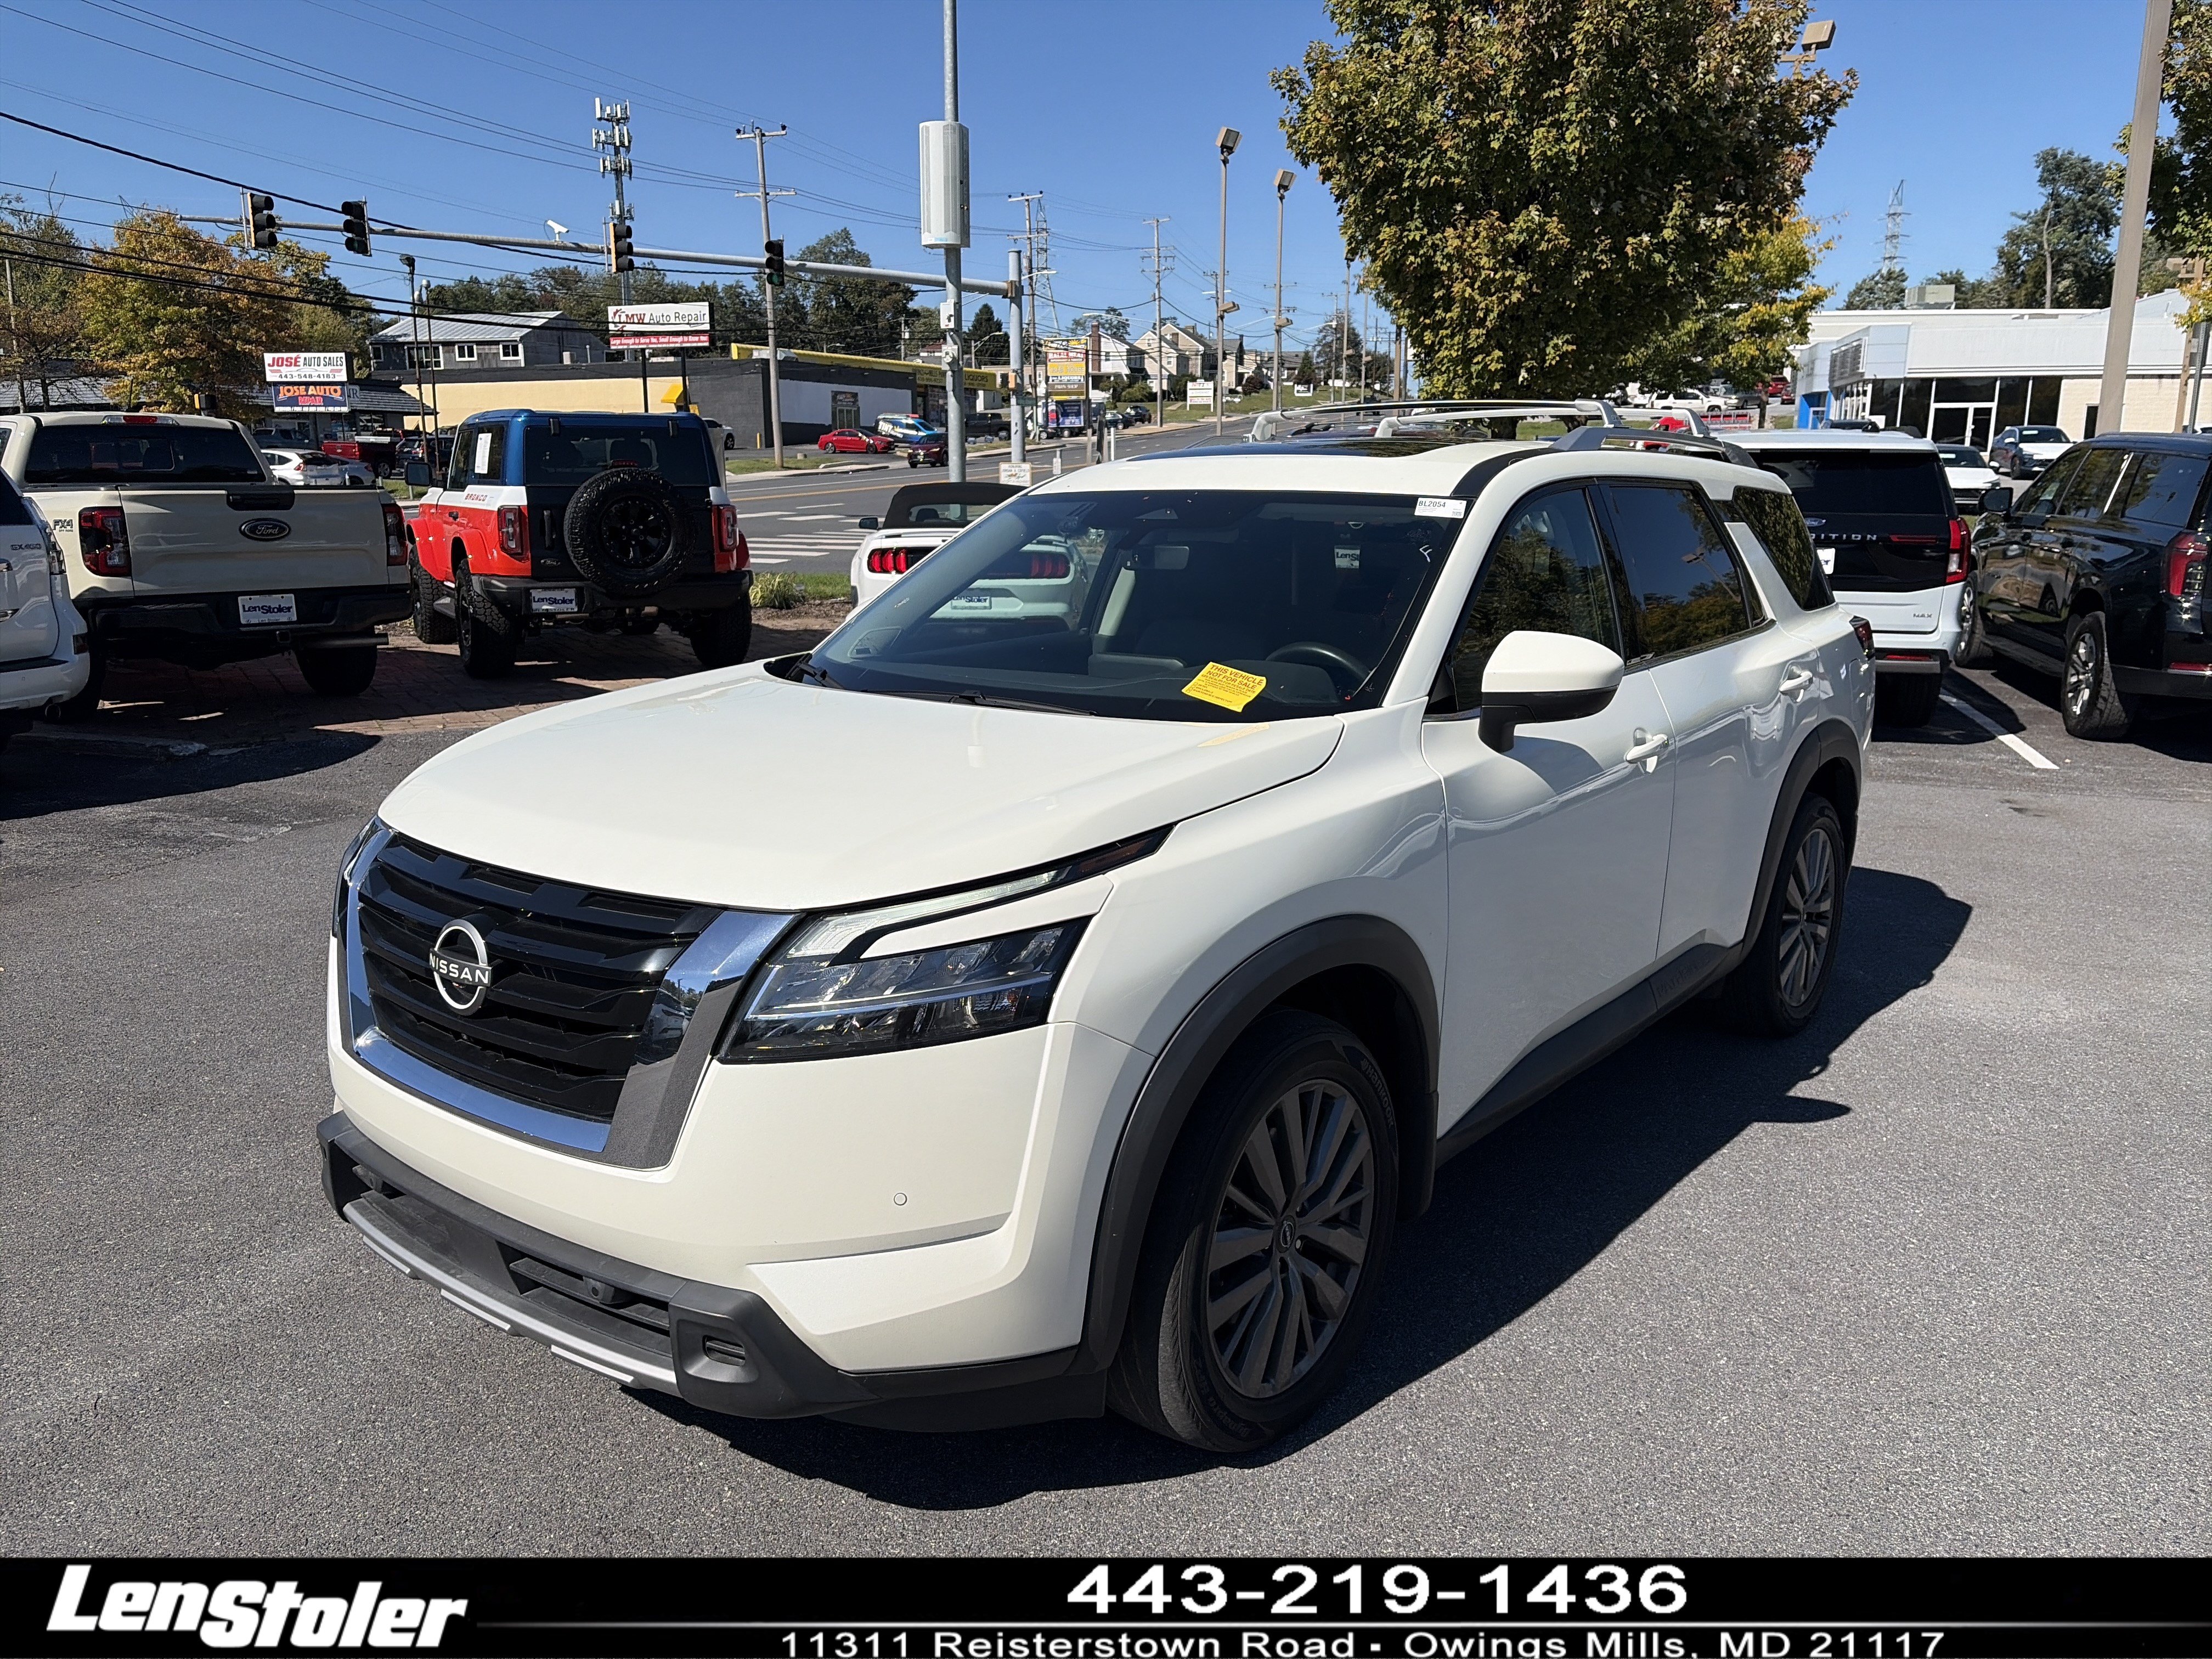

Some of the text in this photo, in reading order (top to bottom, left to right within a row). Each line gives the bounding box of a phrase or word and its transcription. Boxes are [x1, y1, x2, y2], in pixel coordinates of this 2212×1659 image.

[649, 313, 671, 323] Auto
[674, 310, 706, 324] Repair
[268, 354, 343, 367] JOSÉ AUTO SALES
[964, 373, 989, 382] LIQUORS
[279, 386, 306, 398] JOSE
[308, 386, 341, 397] AUTO
[53, 519, 73, 530] FX4
[256, 525, 279, 534] Ford
[1210, 664, 1263, 686] THIS VEHICLE
[1238, 680, 1257, 690] SALE
[430, 953, 489, 983] NISSAN
